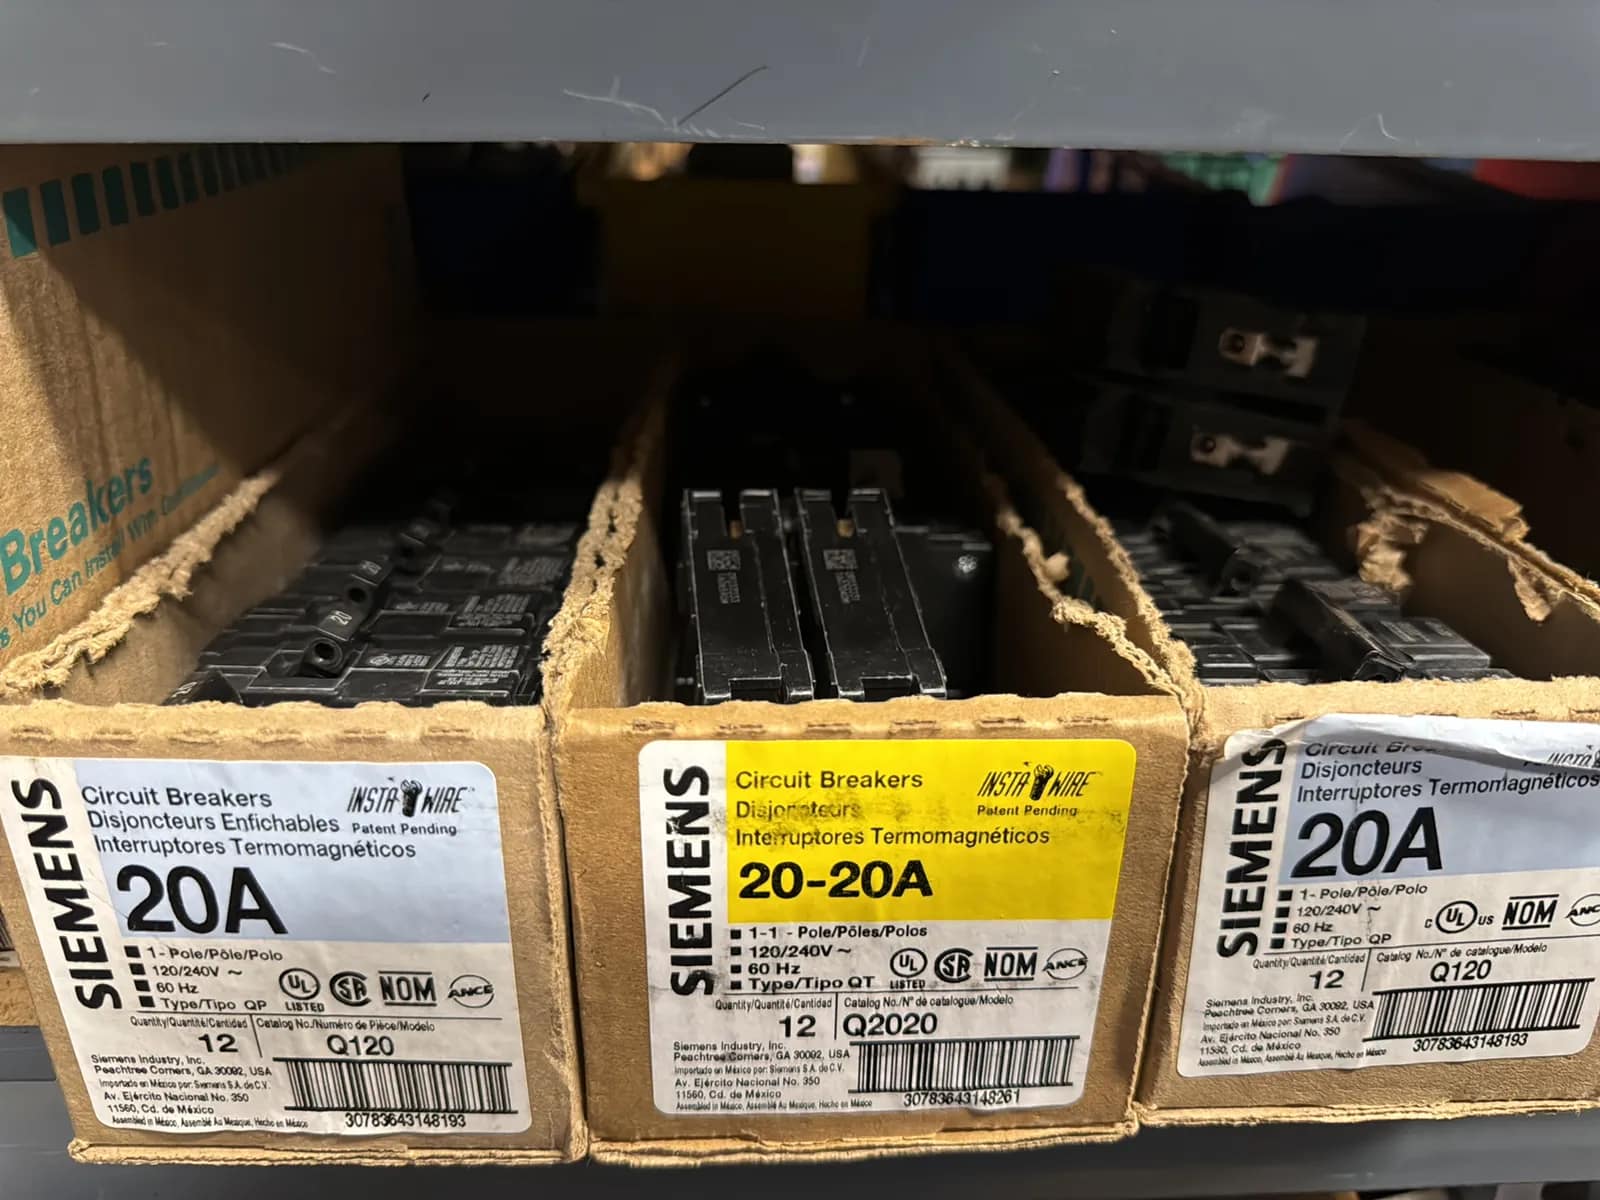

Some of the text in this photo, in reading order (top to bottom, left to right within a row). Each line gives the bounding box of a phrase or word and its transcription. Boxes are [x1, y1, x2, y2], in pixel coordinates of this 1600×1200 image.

[0, 457, 152, 596] Breakers
[13, 597, 47, 633] You
[51, 571, 83, 605] Can
[331, 609, 352, 626] 20
[1301, 759, 1422, 781] Disjoncteurs
[736, 770, 923, 789] Circuit Breakers
[977, 771, 1096, 797] INSTA WIRE
[1297, 772, 1600, 803] Interruptores Termomagnéticos
[82, 786, 272, 807] Circuit Breakers
[347, 786, 467, 813] INSTA WIRE
[977, 805, 1077, 817] Patent Pending
[88, 810, 340, 833] Disjoncteurs Enfichables
[352, 823, 457, 837] Patent Pending
[736, 827, 1049, 848] Interruptores Termomagnéticos
[94, 835, 416, 861] Interruptores Termomagnéticos
[1216, 738, 1287, 957] SIEMENS
[1290, 807, 1442, 878] 20A
[663, 766, 714, 995] SIEMENS
[739, 860, 933, 899] 20-20A
[11, 778, 122, 1009] SIEMENS
[117, 864, 288, 934] 20A
[1320, 884, 1428, 899] Pole/Pôle/Polo
[1297, 904, 1362, 917] 120/240V
[1502, 900, 1557, 925] NOM
[798, 925, 927, 938] Pole/Pôles/Polos
[1292, 922, 1333, 933] 60 Hz
[1292, 934, 1392, 949] Type/Tipo QP
[169, 947, 283, 961] Pole/Pôle/Polo
[749, 945, 833, 958] 120/240V
[1377, 951, 1411, 964] Catalog
[1450, 948, 1462, 958] de
[1465, 942, 1548, 958] catalogue/Modelo
[153, 965, 219, 977] 120/240V
[748, 963, 801, 975] 60 Hz
[984, 952, 1037, 976] NOM
[1430, 959, 1492, 983] Q120
[749, 976, 876, 992] Type/Tipo QT
[890, 979, 926, 990] LISTED
[1309, 969, 1344, 989] 12
[156, 982, 199, 994] 60 Hz
[380, 976, 436, 1001] NOM
[160, 998, 267, 1011] Type/Tipo QP
[285, 1001, 324, 1012] LISTED
[715, 998, 832, 1012] Quantity/Quantité/Cantidad
[844, 997, 880, 1009] Catalog
[929, 994, 1014, 1008] catalogue/Modelo
[1206, 993, 1313, 1008] Siemens Industry, Inc.
[1204, 1007, 1254, 1018] Peachtree
[1302, 1003, 1317, 1012] GA
[1352, 1000, 1375, 1010] USA
[256, 1018, 294, 1031] Catalog
[355, 1019, 367, 1030] de
[779, 1015, 816, 1038] 12
[843, 1012, 937, 1037] Q2020
[1259, 1029, 1301, 1040] Nacional
[1304, 1028, 1319, 1037] No.
[198, 1034, 238, 1052] 12
[327, 1034, 394, 1056] Q120
[673, 1041, 786, 1052] Siemens Industry, Inc.
[1250, 1043, 1263, 1052] de
[1413, 1033, 1528, 1052] 30783643148193
[91, 1055, 205, 1066] Siemens Industry, Inc.
[673, 1052, 727, 1062] Peachtree
[776, 1051, 790, 1060] GA
[828, 1049, 850, 1059] USA
[95, 1065, 147, 1075] Peachtree
[196, 1066, 213, 1076] GA
[249, 1066, 272, 1076] USA
[675, 1076, 820, 1088] Av. Ejército Nacional No. 350
[104, 1091, 249, 1103] Av. Ejército Nacional No. 350
[709, 1090, 726, 1099] Cd.
[729, 1090, 743, 1099] de
[745, 1089, 781, 1098] México
[904, 1088, 1020, 1106] 30783643148261
[141, 1105, 158, 1114] Cd.
[161, 1105, 174, 1114] de
[177, 1104, 213, 1114] México
[345, 1112, 466, 1127] 30783643148193
